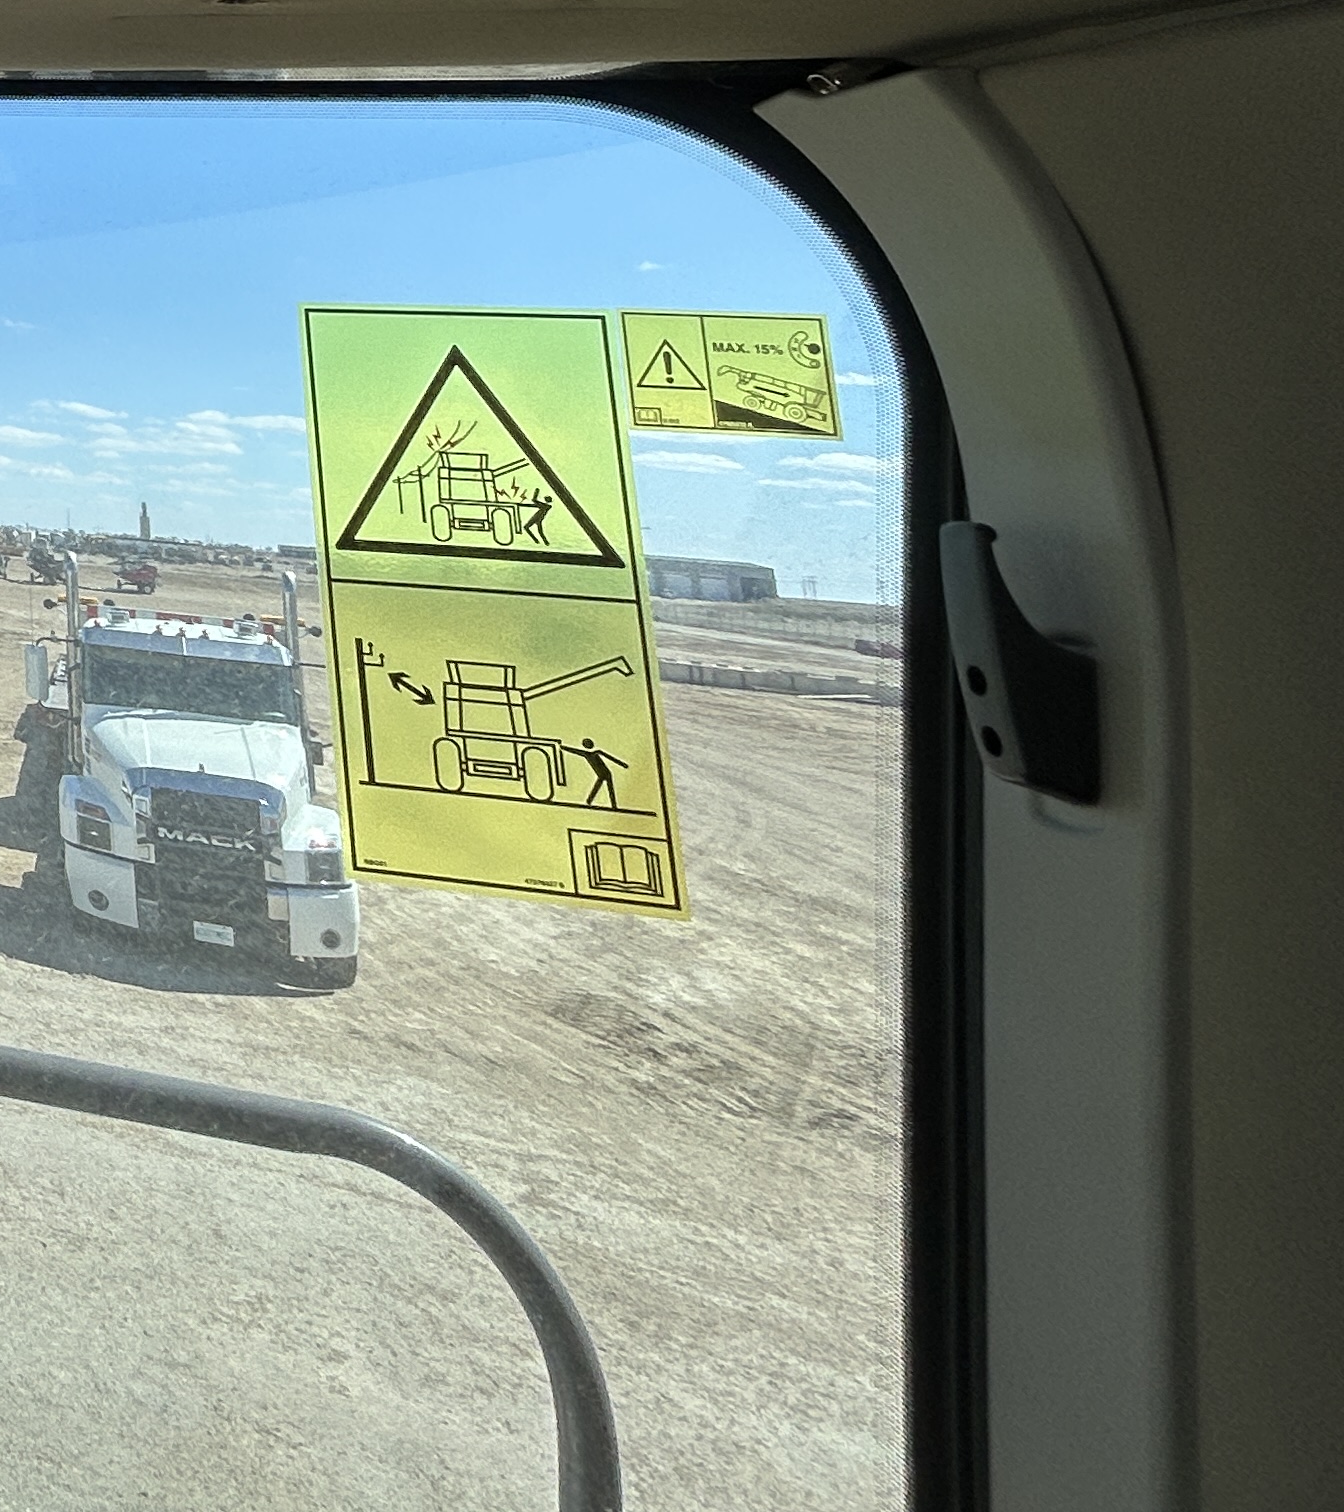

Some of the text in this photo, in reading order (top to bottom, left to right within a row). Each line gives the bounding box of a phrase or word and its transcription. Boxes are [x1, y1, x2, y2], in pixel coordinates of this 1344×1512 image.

[712, 342, 784, 356] MAX. 15%
[157, 826, 256, 851] MACK
